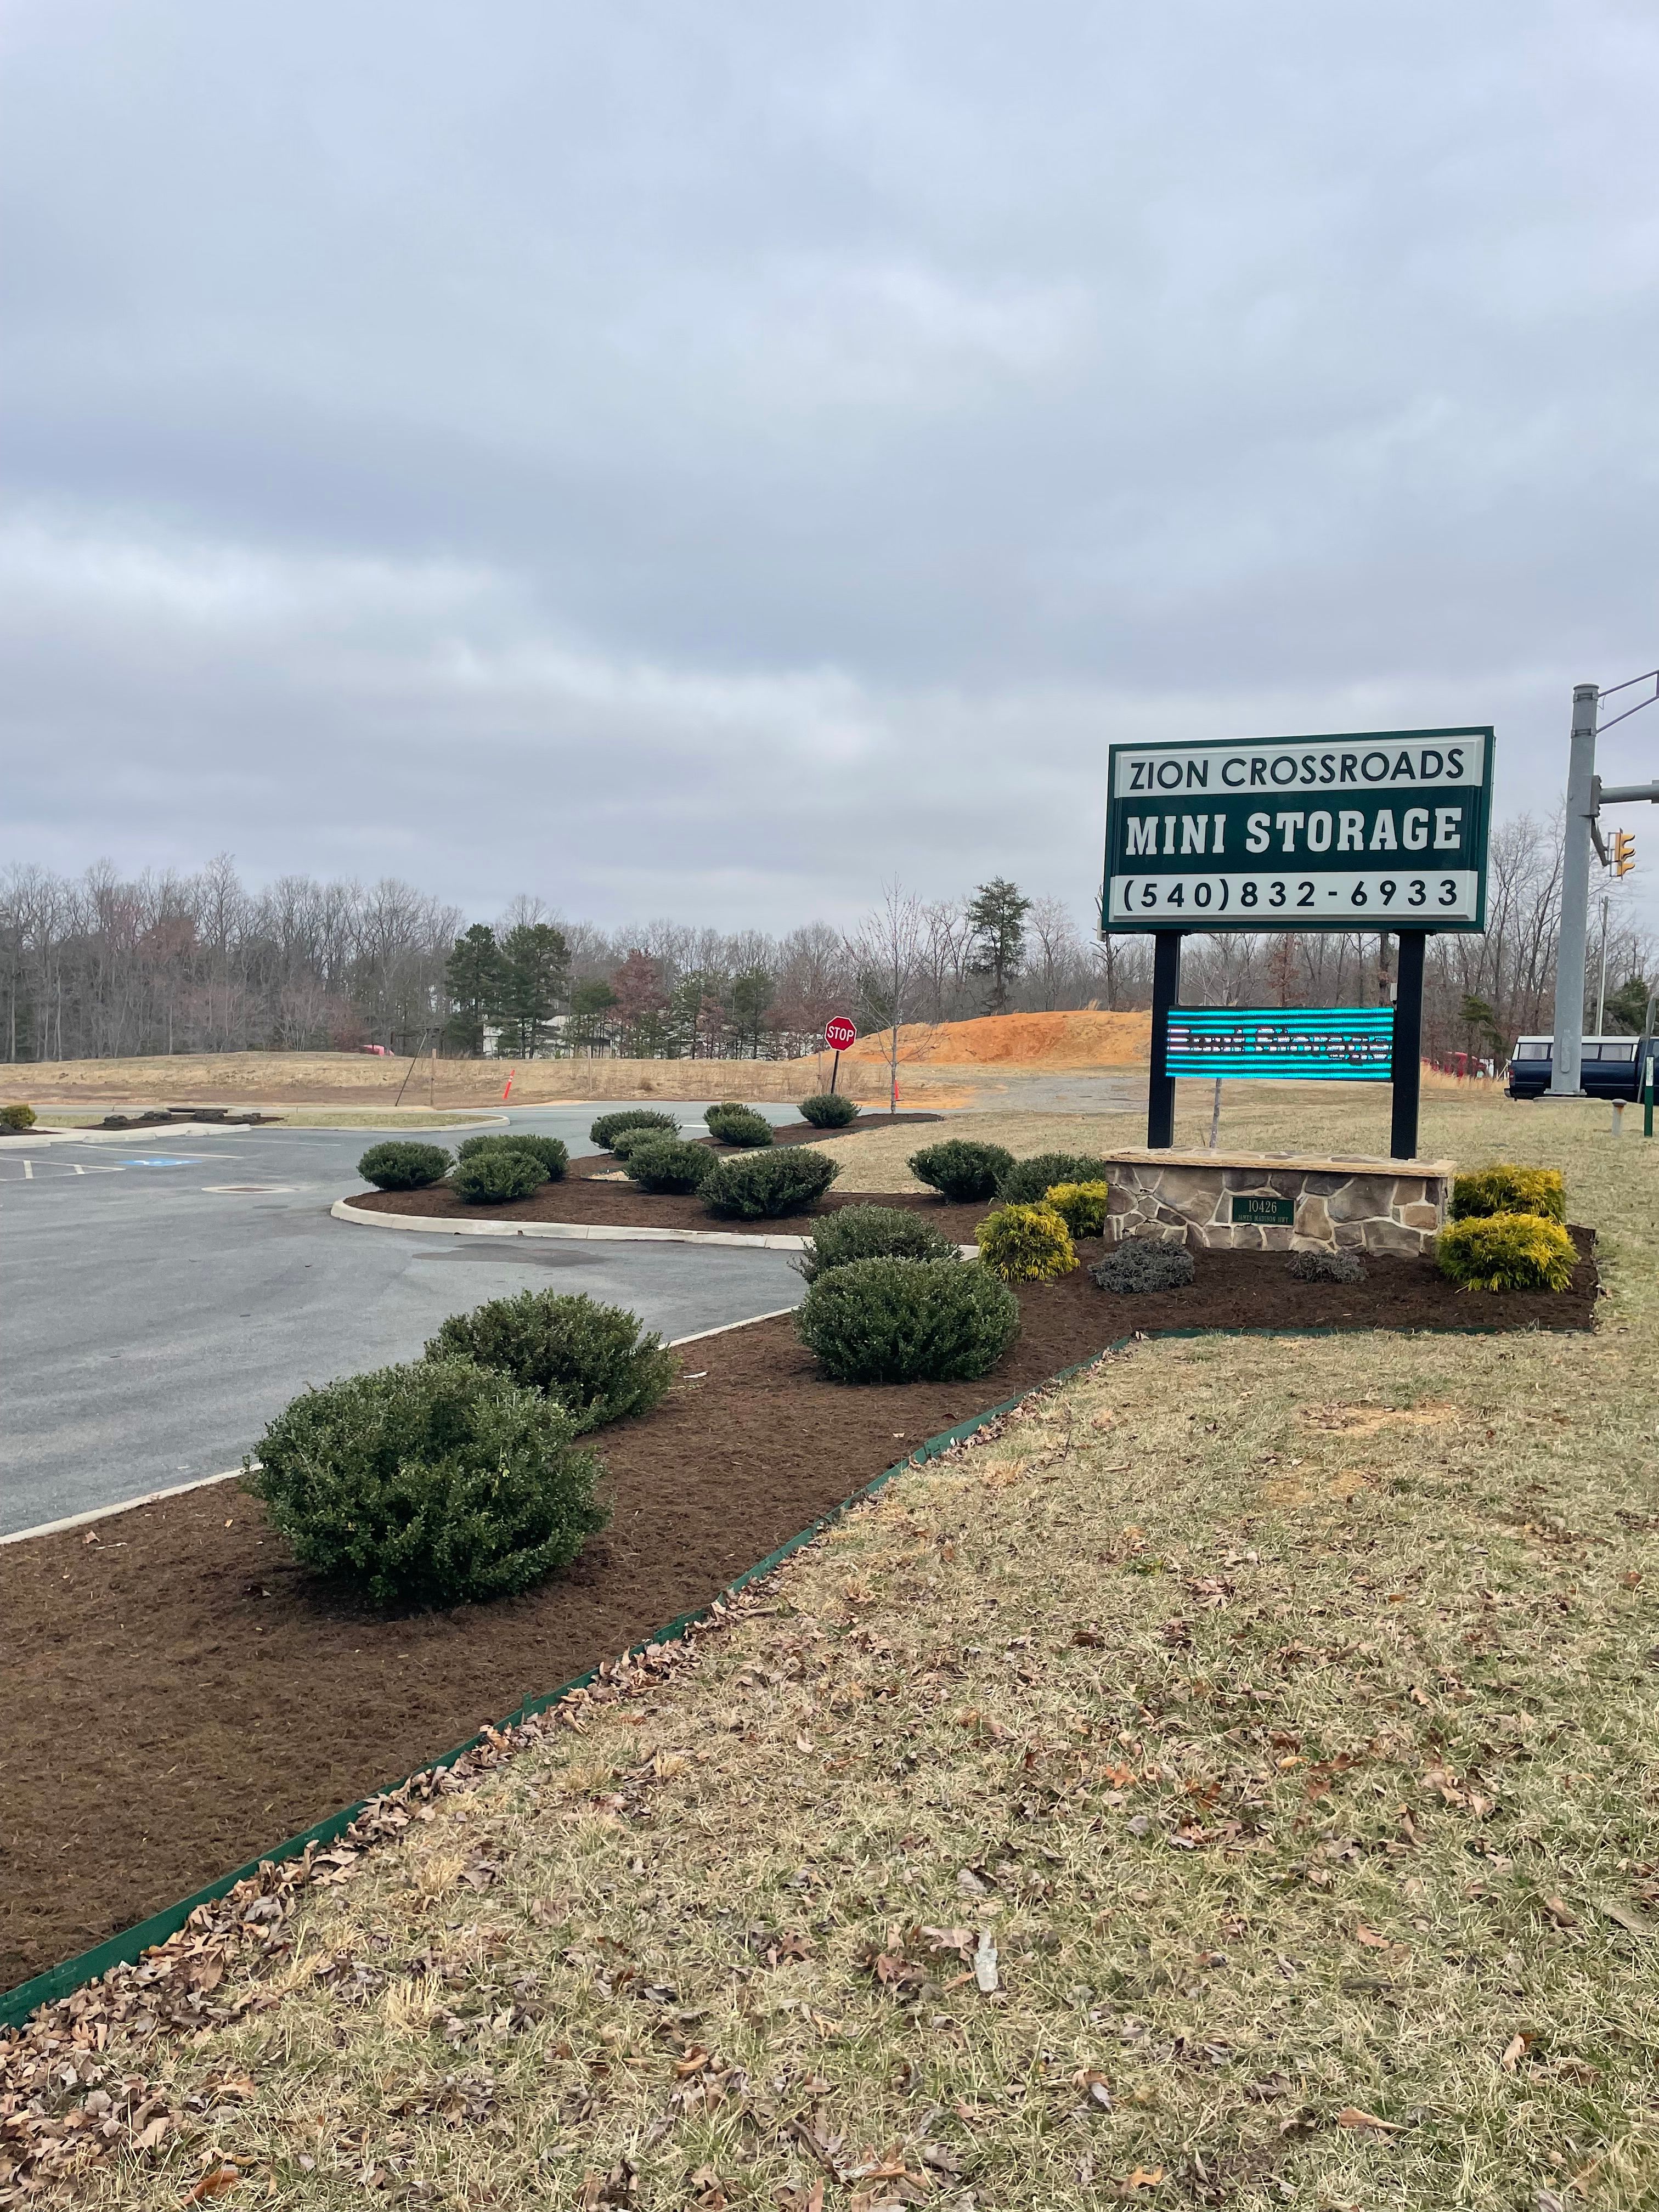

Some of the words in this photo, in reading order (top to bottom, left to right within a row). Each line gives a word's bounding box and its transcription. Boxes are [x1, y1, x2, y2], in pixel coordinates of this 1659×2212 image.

[1129, 759, 1208, 790] ZION
[1221, 748, 1464, 787] CROSSROADS
[1125, 814, 1227, 856] MINI
[1245, 806, 1463, 854] STORAGE
[1123, 878, 1457, 911] (540)832-6933
[827, 1025, 854, 1042] STOP
[1248, 1200, 1277, 1214] 10426
